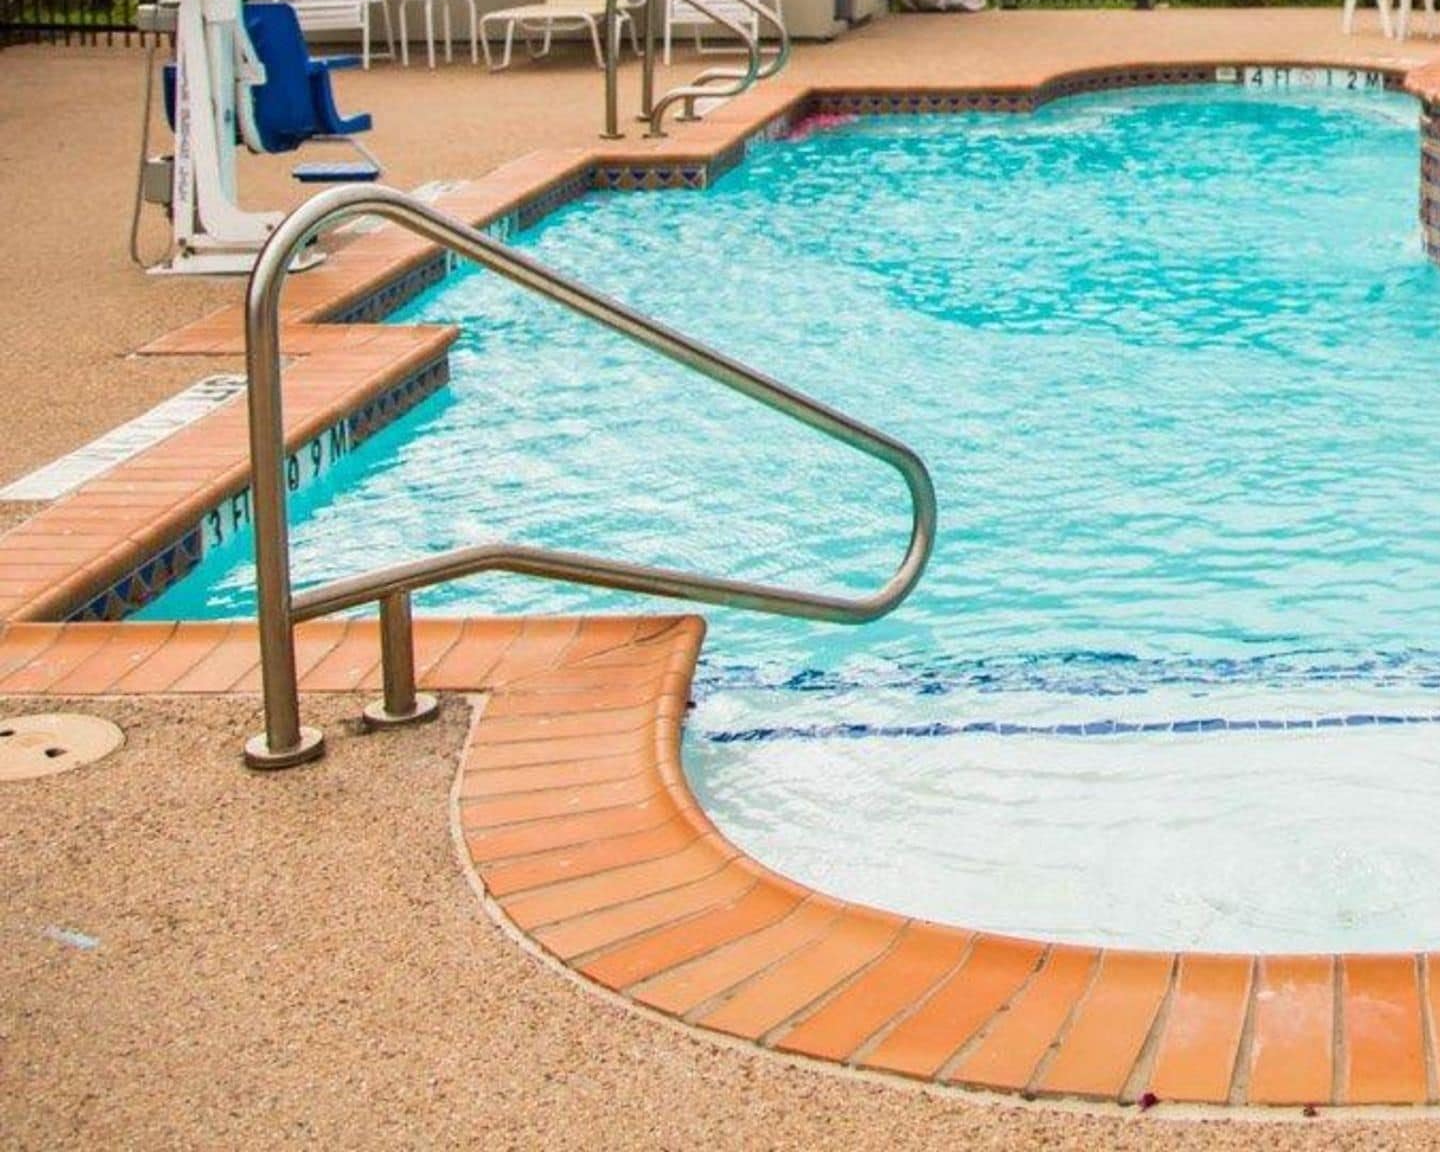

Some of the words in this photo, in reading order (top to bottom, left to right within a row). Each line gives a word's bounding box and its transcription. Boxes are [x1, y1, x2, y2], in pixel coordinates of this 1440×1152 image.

[1252, 69, 1263, 86] 4
[1275, 68, 1289, 86] FT
[311, 437, 321, 478] 9
